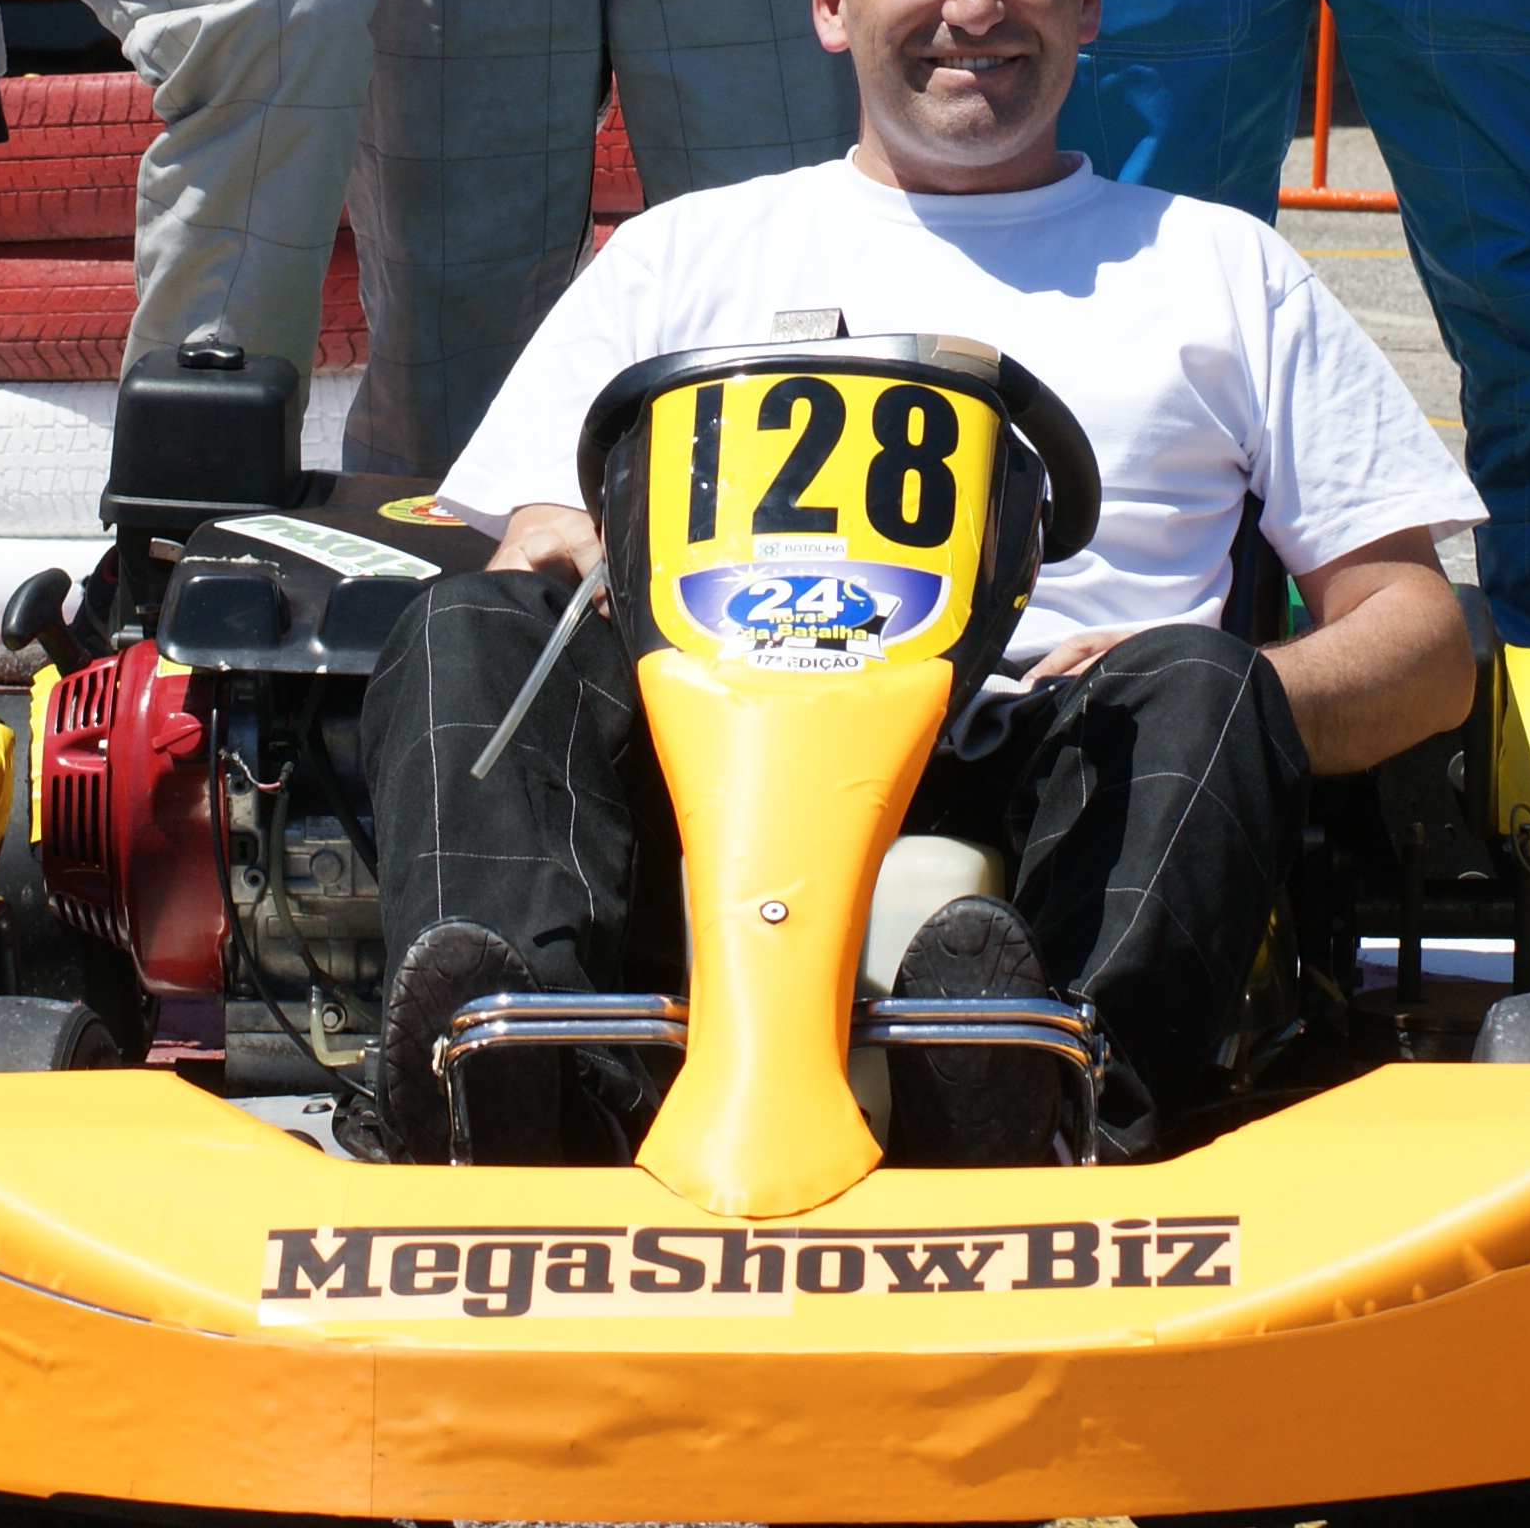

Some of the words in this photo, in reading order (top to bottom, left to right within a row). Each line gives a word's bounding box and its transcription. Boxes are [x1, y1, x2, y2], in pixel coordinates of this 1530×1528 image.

[687, 376, 960, 548] 128
[785, 544, 845, 553] BATALHA
[747, 578, 845, 620] 24
[741, 627, 769, 641] da
[777, 623, 869, 642] Batalha
[769, 612, 829, 624] horas
[267, 1215, 1241, 1318] MegaShowBiz
